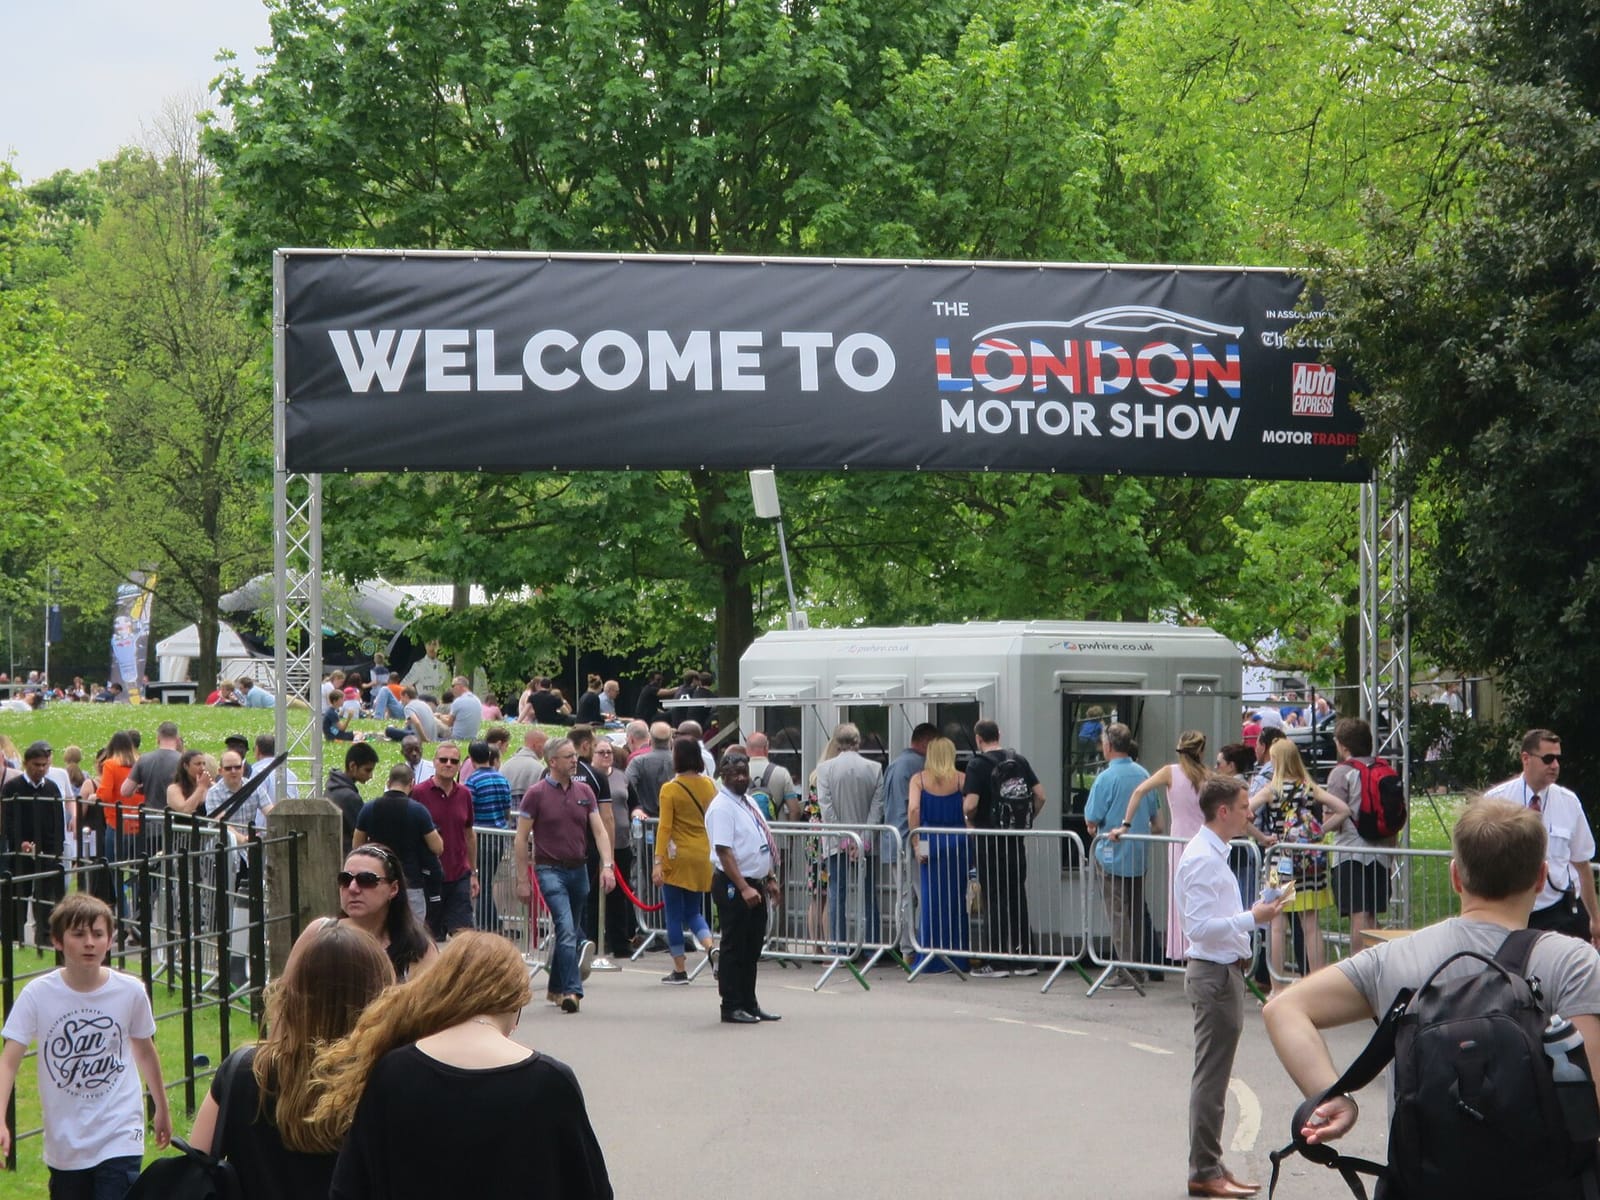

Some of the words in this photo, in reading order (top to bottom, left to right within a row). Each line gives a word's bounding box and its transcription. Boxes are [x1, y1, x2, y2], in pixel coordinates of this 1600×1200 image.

[933, 301, 970, 317] THE
[1265, 310, 1276, 319] IN
[328, 329, 766, 393] WELCOME
[781, 331, 897, 393] TO
[935, 337, 1241, 399] LONDON
[1294, 365, 1336, 395] Auto
[941, 399, 1102, 437] MOTOR
[1109, 402, 1240, 442] SHOW
[1294, 394, 1334, 414] EXPRESS
[1078, 641, 1154, 652] pwhire.co.uk
[51, 1016, 113, 1058] San
[53, 1053, 125, 1089] Fran
